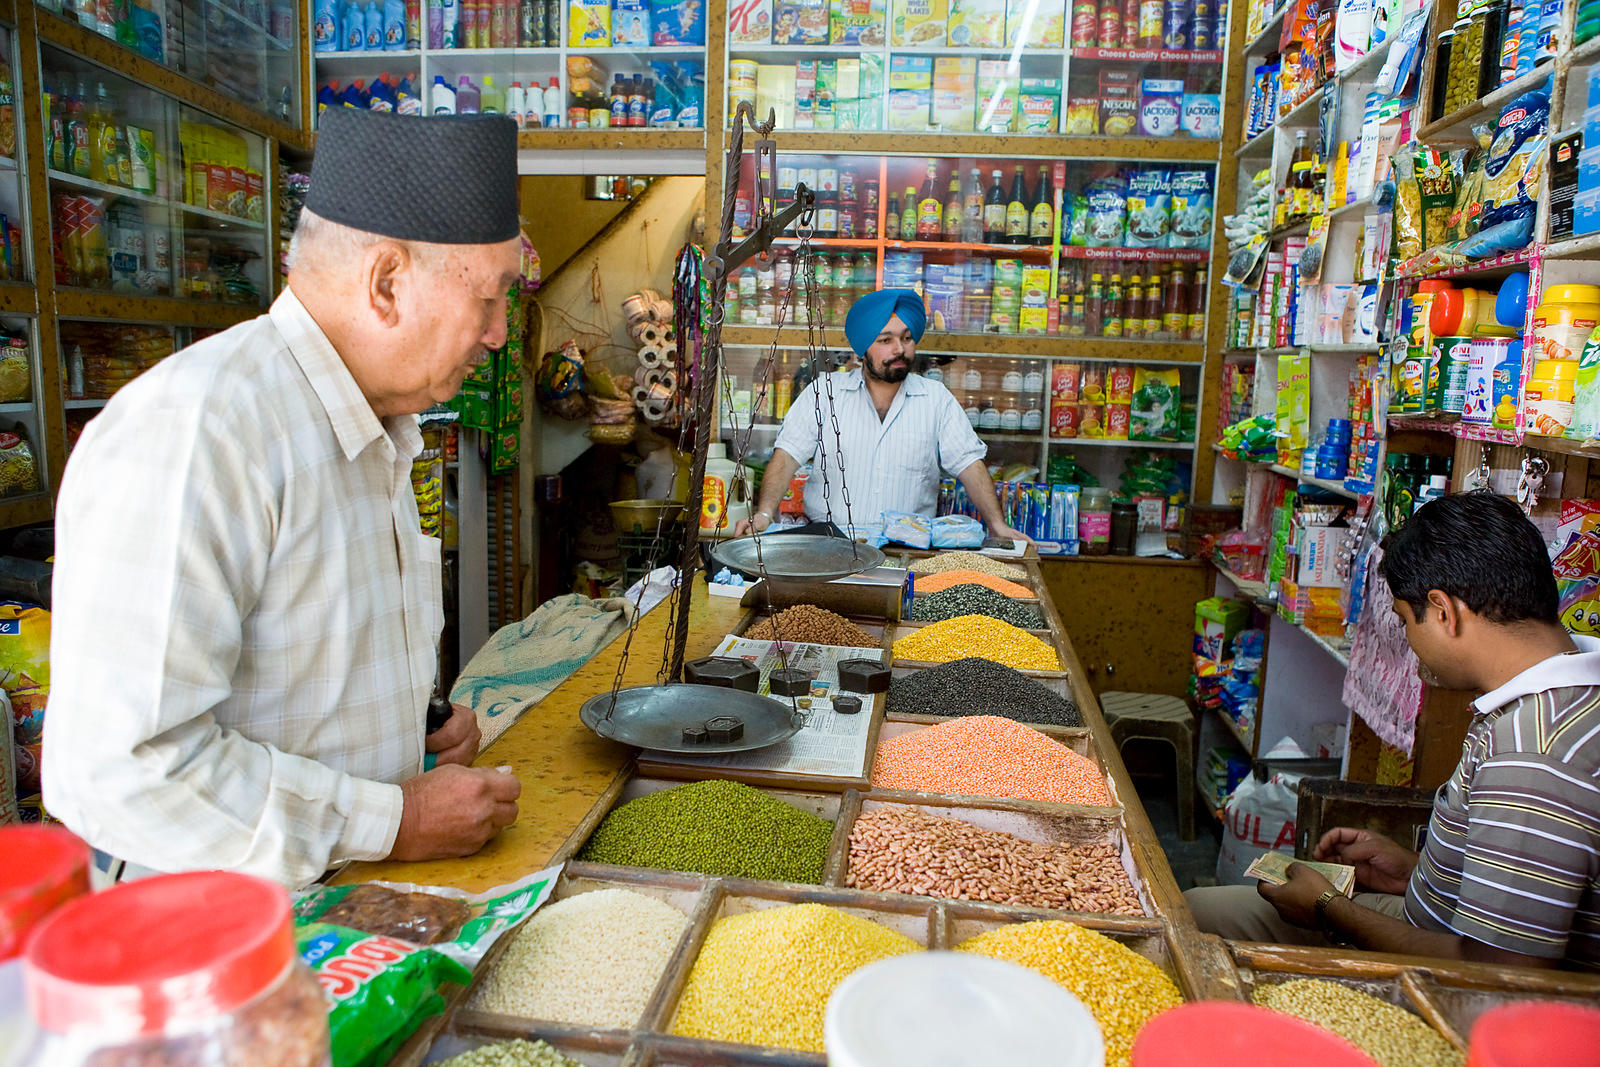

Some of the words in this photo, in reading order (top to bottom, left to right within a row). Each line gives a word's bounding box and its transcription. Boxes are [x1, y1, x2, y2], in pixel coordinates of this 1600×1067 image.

[906, 7, 930, 15] FLAKES
[847, 18, 871, 26] FREE
[1098, 50, 1127, 59] Choose
[1129, 51, 1158, 61] Quality
[1160, 51, 1189, 60] Choose
[1023, 101, 1054, 112] CERELAC
[1144, 106, 1178, 116] LACTOGEN
[1186, 106, 1219, 116] LACTOGEN
[1152, 117, 1160, 130] 3
[1194, 117, 1201, 130] 2
[1130, 179, 1172, 193] EveryDay
[1085, 249, 1114, 258] Choose
[1115, 250, 1144, 259] Quality
[1146, 251, 1174, 259] Choose
